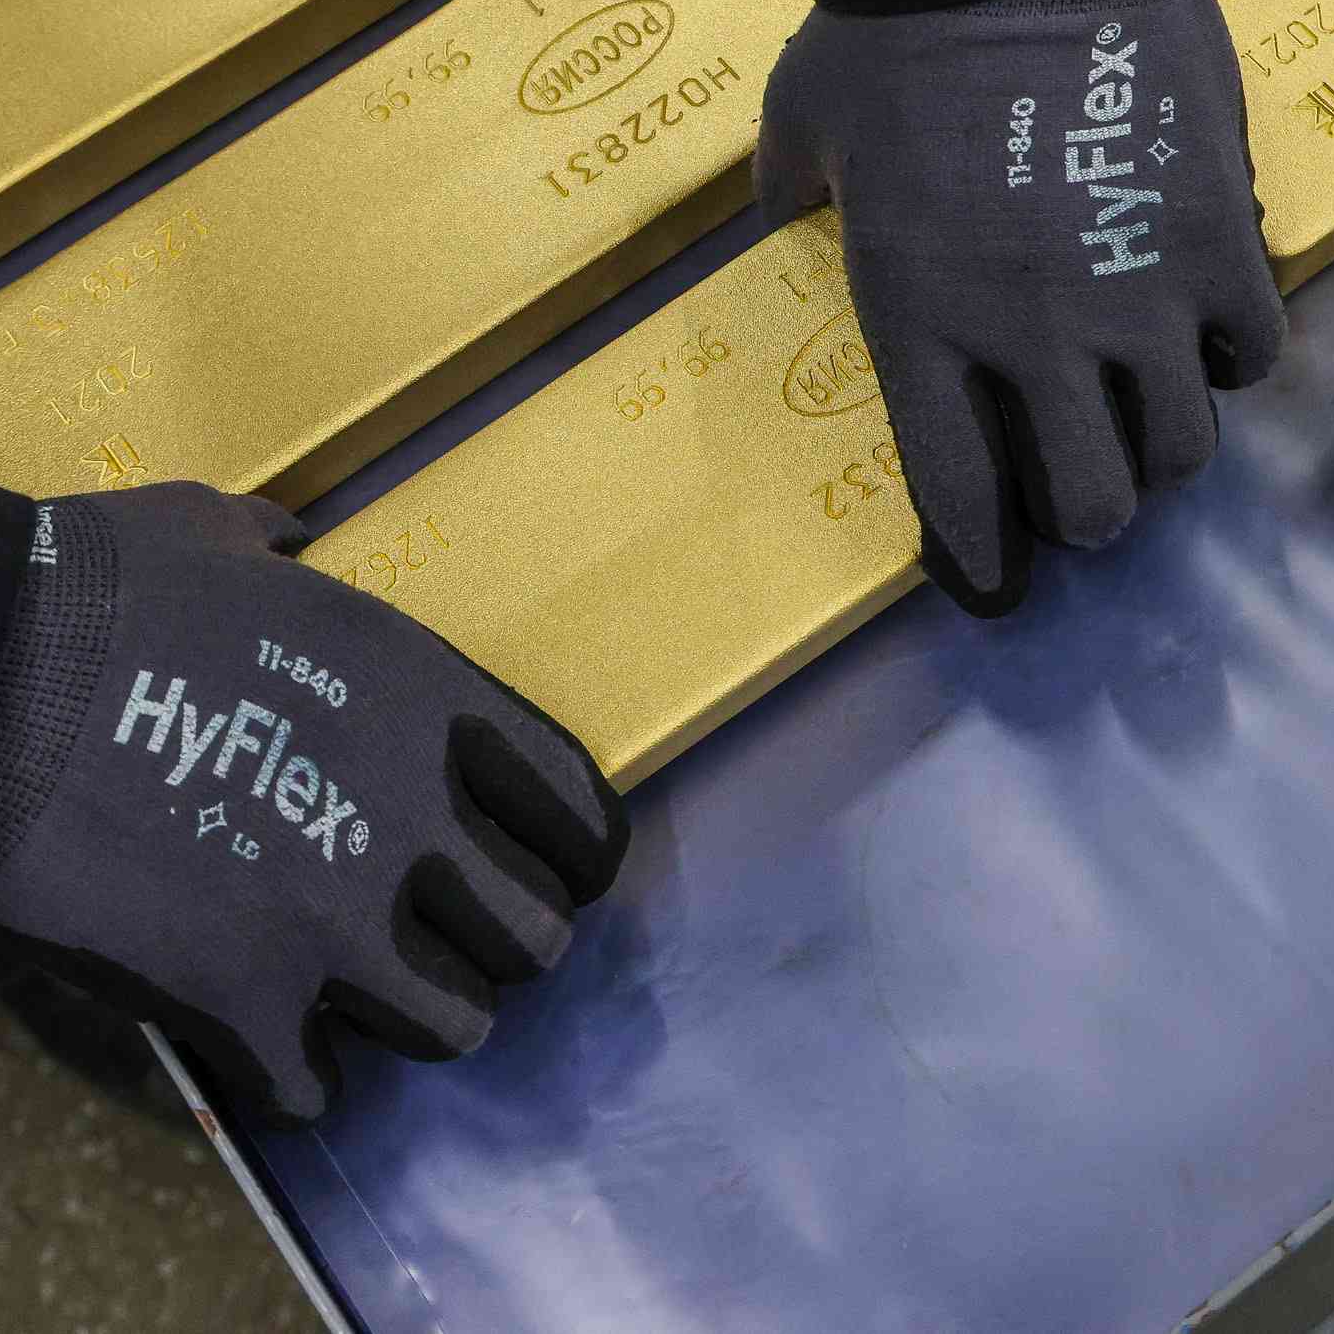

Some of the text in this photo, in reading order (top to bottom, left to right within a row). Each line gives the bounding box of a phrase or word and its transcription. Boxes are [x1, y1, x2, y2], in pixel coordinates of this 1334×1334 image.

[356, 37, 474, 128] 99,99
[528, 5, 666, 110] РОССИЯ
[1006, 97, 1036, 188] 11-840
[42, 342, 156, 427] 2021
[606, 324, 733, 426] 99,99
[29, 505, 58, 564] nsell
[259, 639, 348, 708] 11-840
